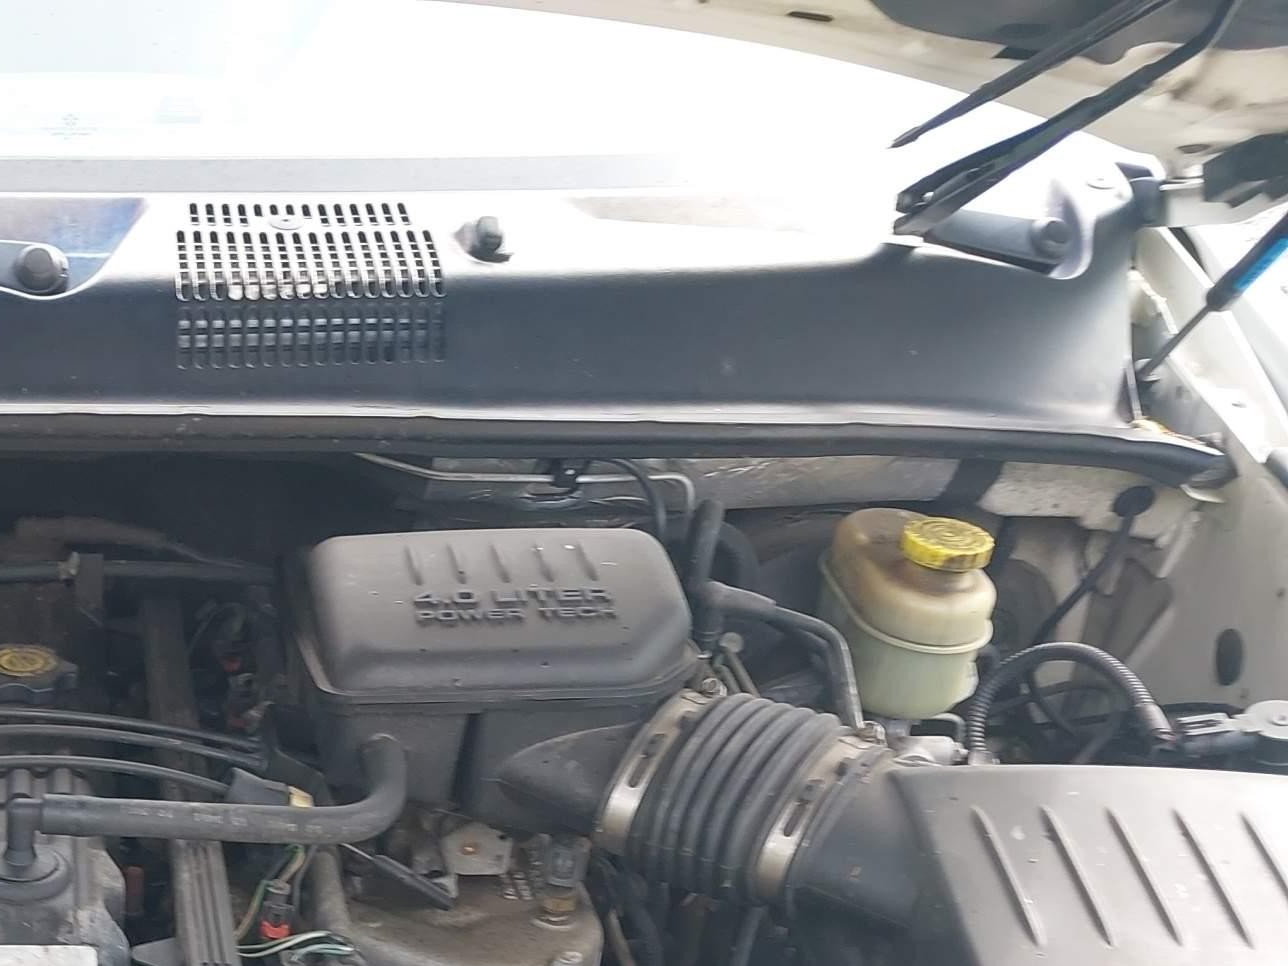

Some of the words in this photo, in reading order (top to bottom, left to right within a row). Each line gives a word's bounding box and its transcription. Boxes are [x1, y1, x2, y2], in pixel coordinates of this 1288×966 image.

[414, 588, 479, 608] 4.0
[490, 585, 612, 608] LITER
[415, 608, 527, 627] POWER
[537, 605, 617, 624] TECH
